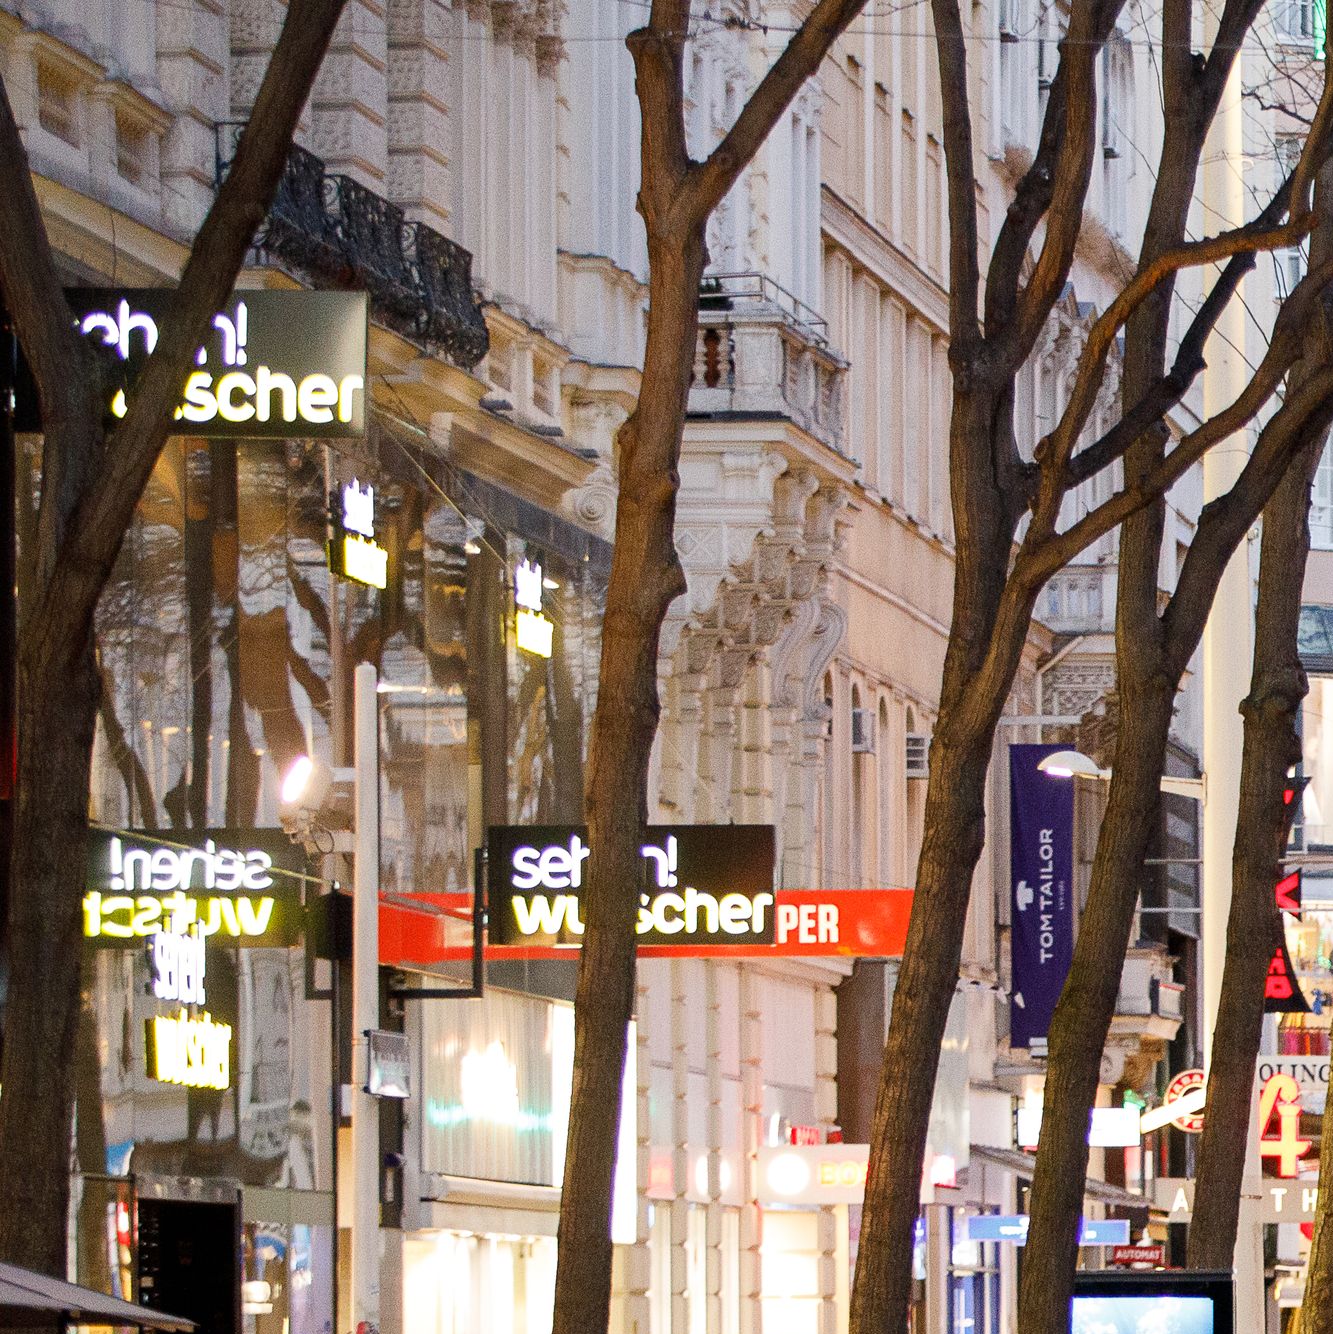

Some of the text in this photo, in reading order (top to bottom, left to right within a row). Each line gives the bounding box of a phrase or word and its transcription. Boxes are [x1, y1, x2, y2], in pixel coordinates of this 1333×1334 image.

[1039, 828, 1054, 965] TOM TAILOR
[777, 903, 839, 943] PER
[1115, 1250, 1161, 1261] AUTOMAT
